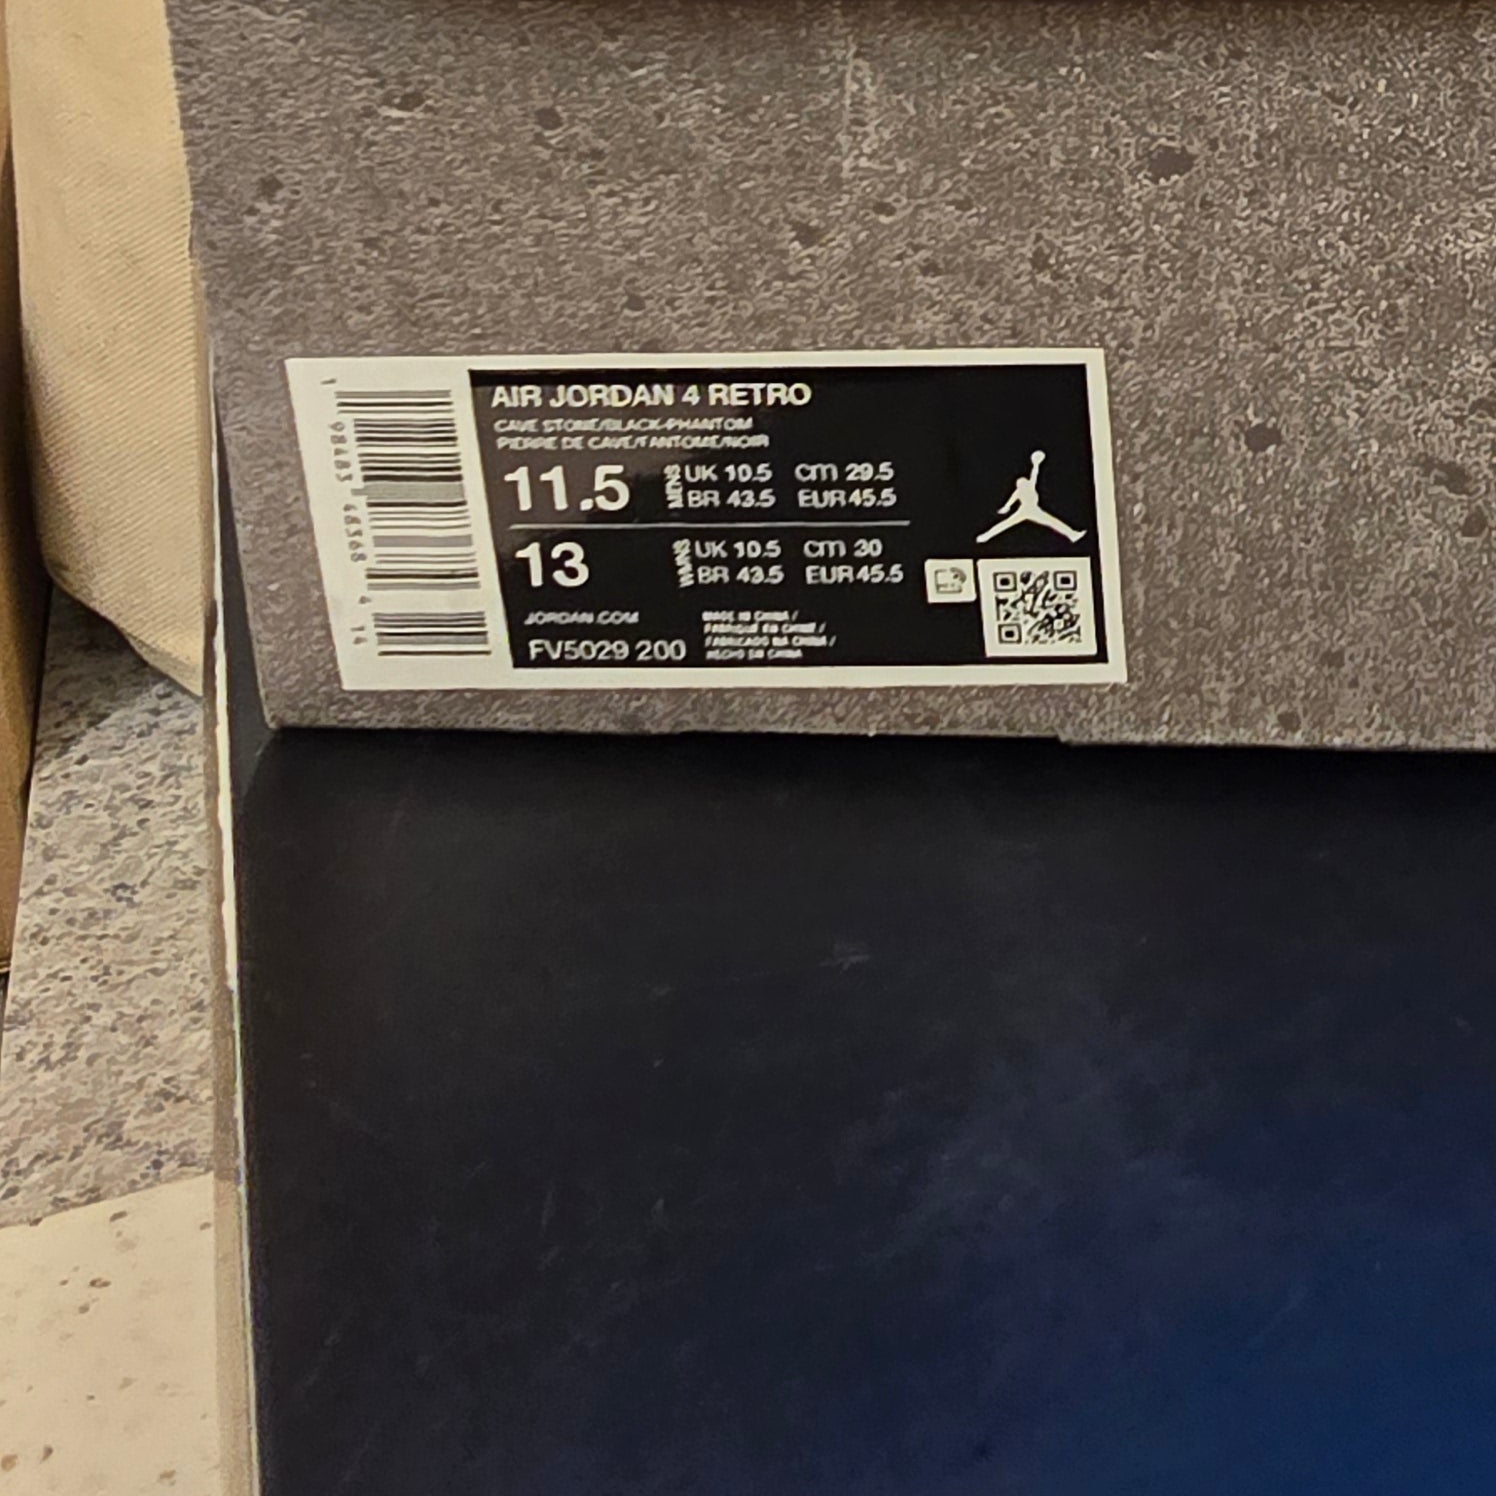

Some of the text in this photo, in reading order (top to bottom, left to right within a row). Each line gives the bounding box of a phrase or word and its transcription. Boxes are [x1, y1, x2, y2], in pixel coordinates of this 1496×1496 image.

[491, 382, 813, 408] AIR JORDAN 4 RETRO
[685, 464, 718, 483] UK
[725, 462, 773, 483] 10.5
[845, 461, 895, 482] 29.5
[504, 465, 630, 511] 11.5
[687, 487, 897, 509] BR 43.5 EUR 45.5
[695, 539, 728, 559] UK
[733, 539, 782, 559] 10.5
[853, 538, 883, 558] 30
[514, 541, 590, 588] 13
[697, 563, 904, 585] BR 43.5 EUR 45.5
[524, 611, 640, 625] JORDAN.COM
[528, 638, 687, 661] FV5029 200
